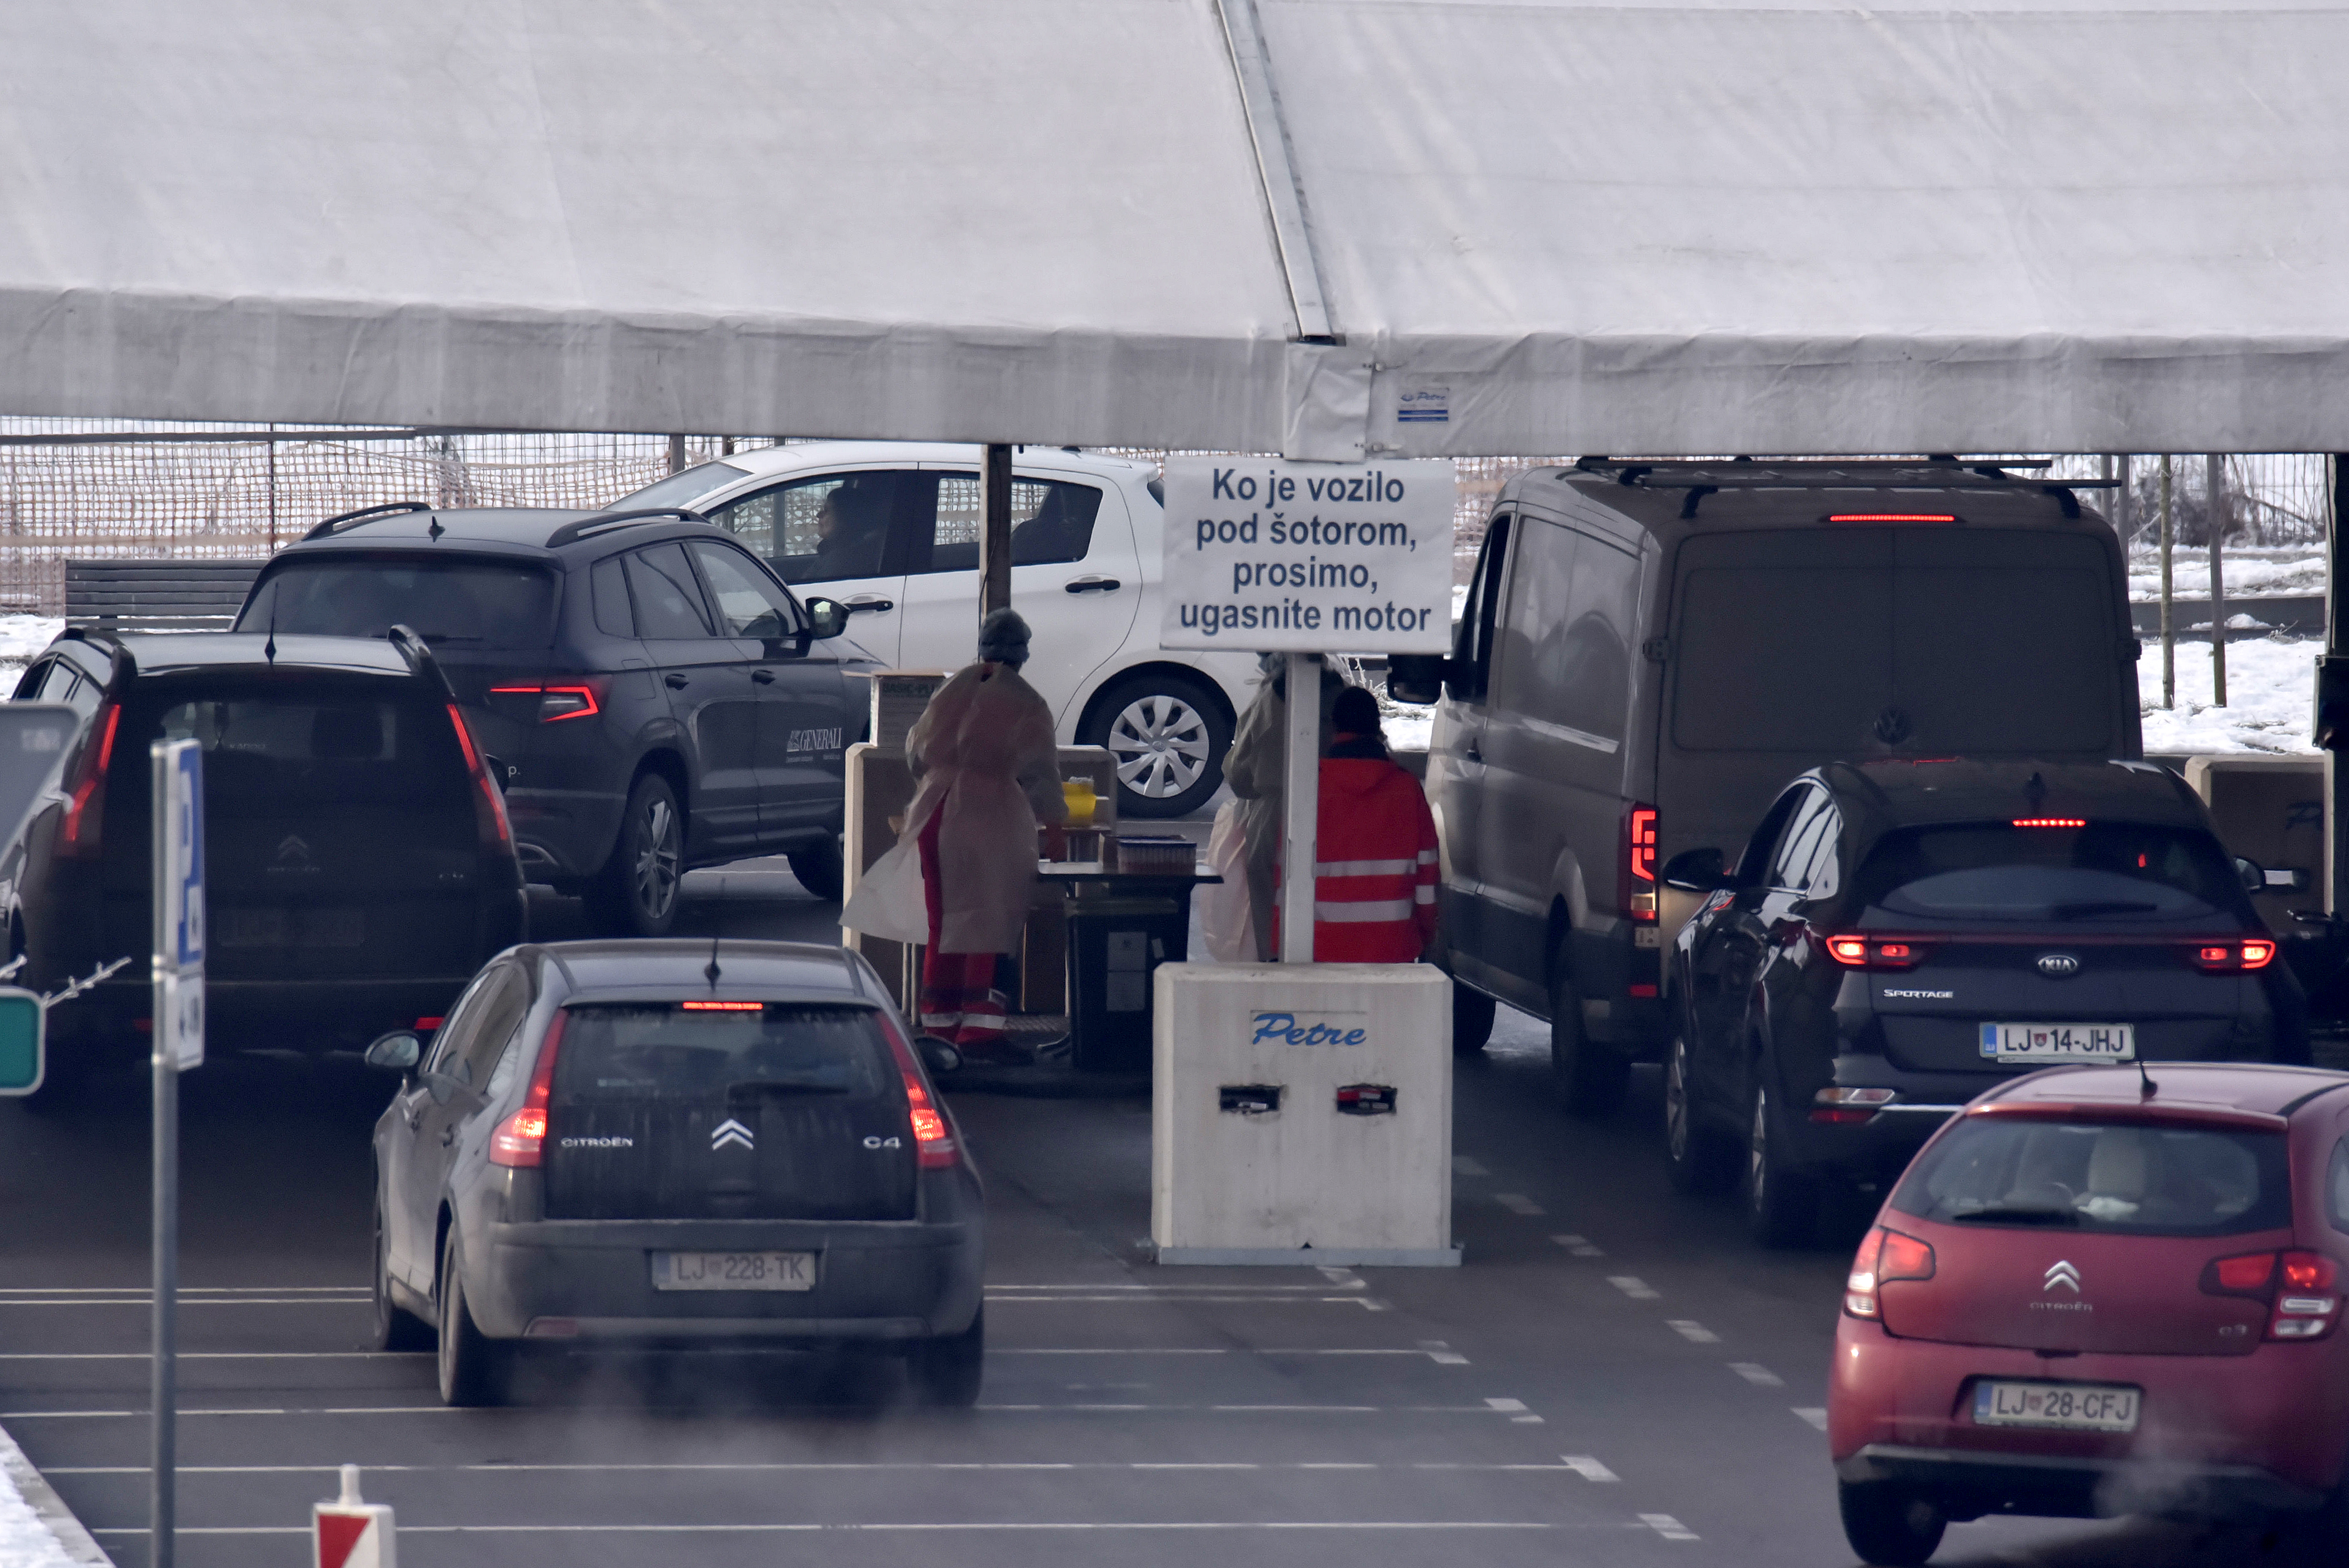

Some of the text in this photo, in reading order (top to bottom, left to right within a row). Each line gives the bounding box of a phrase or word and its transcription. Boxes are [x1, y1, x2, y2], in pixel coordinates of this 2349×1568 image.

[1213, 468, 1405, 509] Ko je vozilo
[1196, 512, 1417, 552] pod šotorom,
[1233, 556, 1378, 594] prosimo,
[1180, 598, 1432, 636] ugasnite motor
[800, 728, 842, 752] GENERALI
[2044, 958, 2073, 971] KIA
[1883, 989, 1954, 999] SPORTAGE
[1252, 1012, 1366, 1046] Petre
[2004, 1028, 2124, 1052] LJ 14-JHJ
[862, 1135, 902, 1149] C4
[677, 1255, 805, 1280] LJ 228-TK
[1996, 1389, 2131, 1421] LJ 28-CFJ
